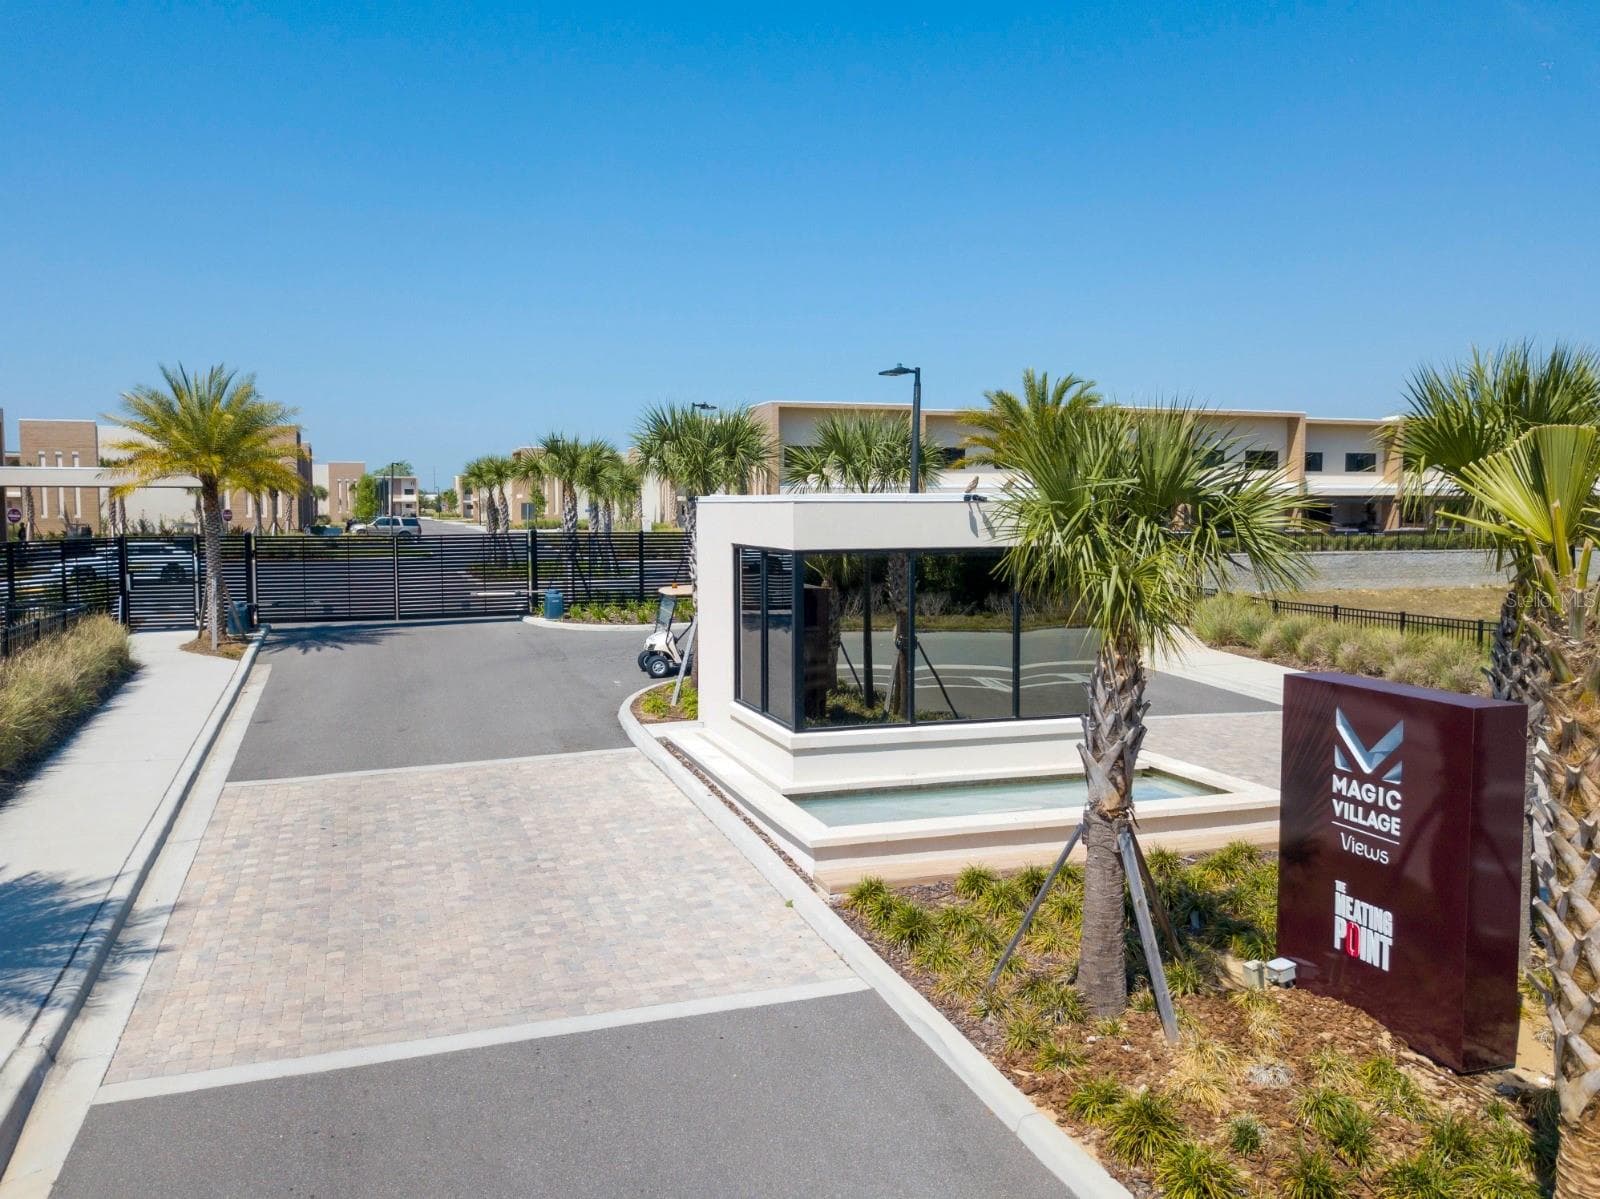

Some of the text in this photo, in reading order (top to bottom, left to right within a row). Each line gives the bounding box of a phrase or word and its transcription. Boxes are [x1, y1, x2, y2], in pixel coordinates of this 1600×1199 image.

[1332, 774, 1401, 811] MAGIC
[1332, 798, 1401, 837] VILLAGE
[1340, 832, 1389, 865] Views
[1334, 915, 1393, 972] POINT
